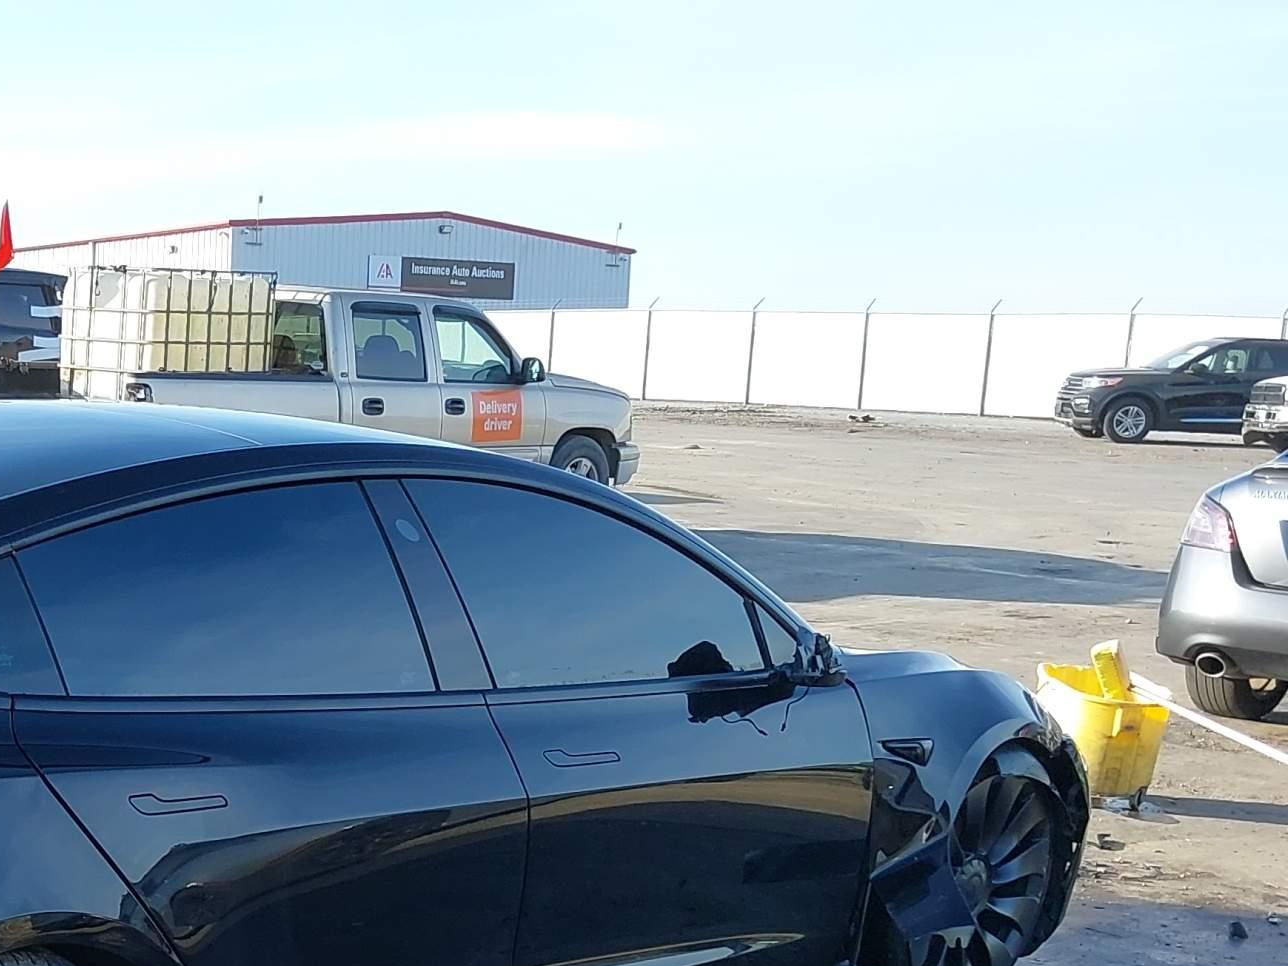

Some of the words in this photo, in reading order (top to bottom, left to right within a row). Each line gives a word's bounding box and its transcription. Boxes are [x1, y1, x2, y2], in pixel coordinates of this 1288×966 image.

[411, 262, 450, 276] Insurance
[452, 265, 470, 277] Auto
[471, 266, 505, 279] Auctions
[479, 400, 517, 416] Delivery
[484, 417, 513, 431] driver
